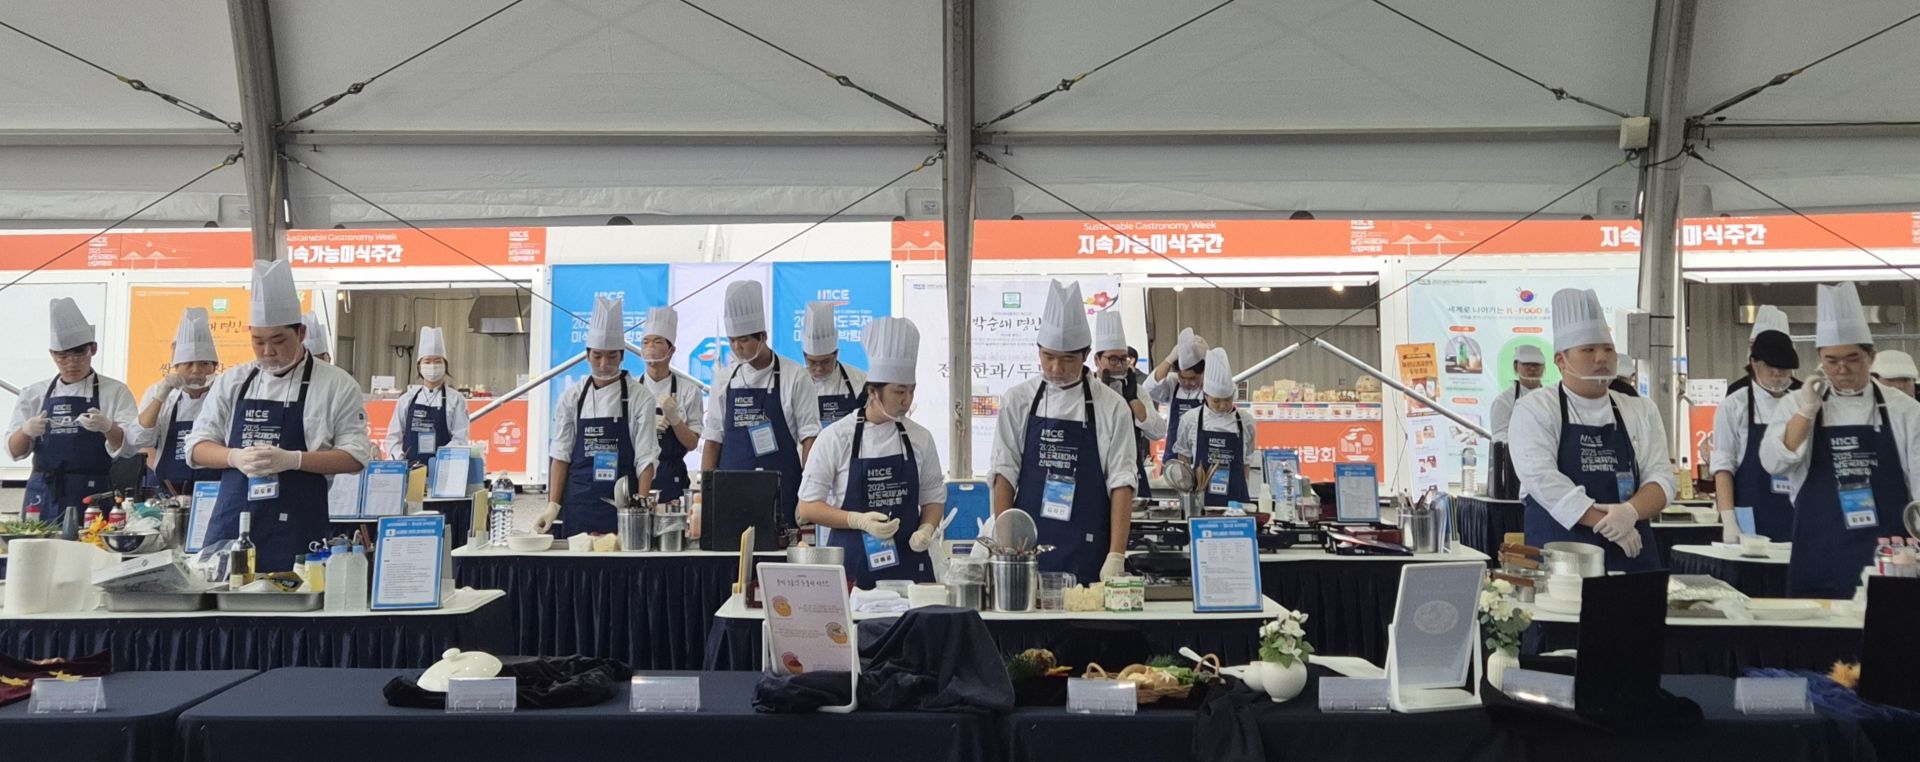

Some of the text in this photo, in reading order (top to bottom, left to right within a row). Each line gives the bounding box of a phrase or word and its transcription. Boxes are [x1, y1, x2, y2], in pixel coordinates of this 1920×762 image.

[1191, 221, 1216, 229] Week
[1601, 224, 1766, 247] 지속미식주간
[1078, 233, 1224, 254] 지속가능미식주간
[867, 467, 893, 477] NICE
[867, 483, 886, 492] 2025
